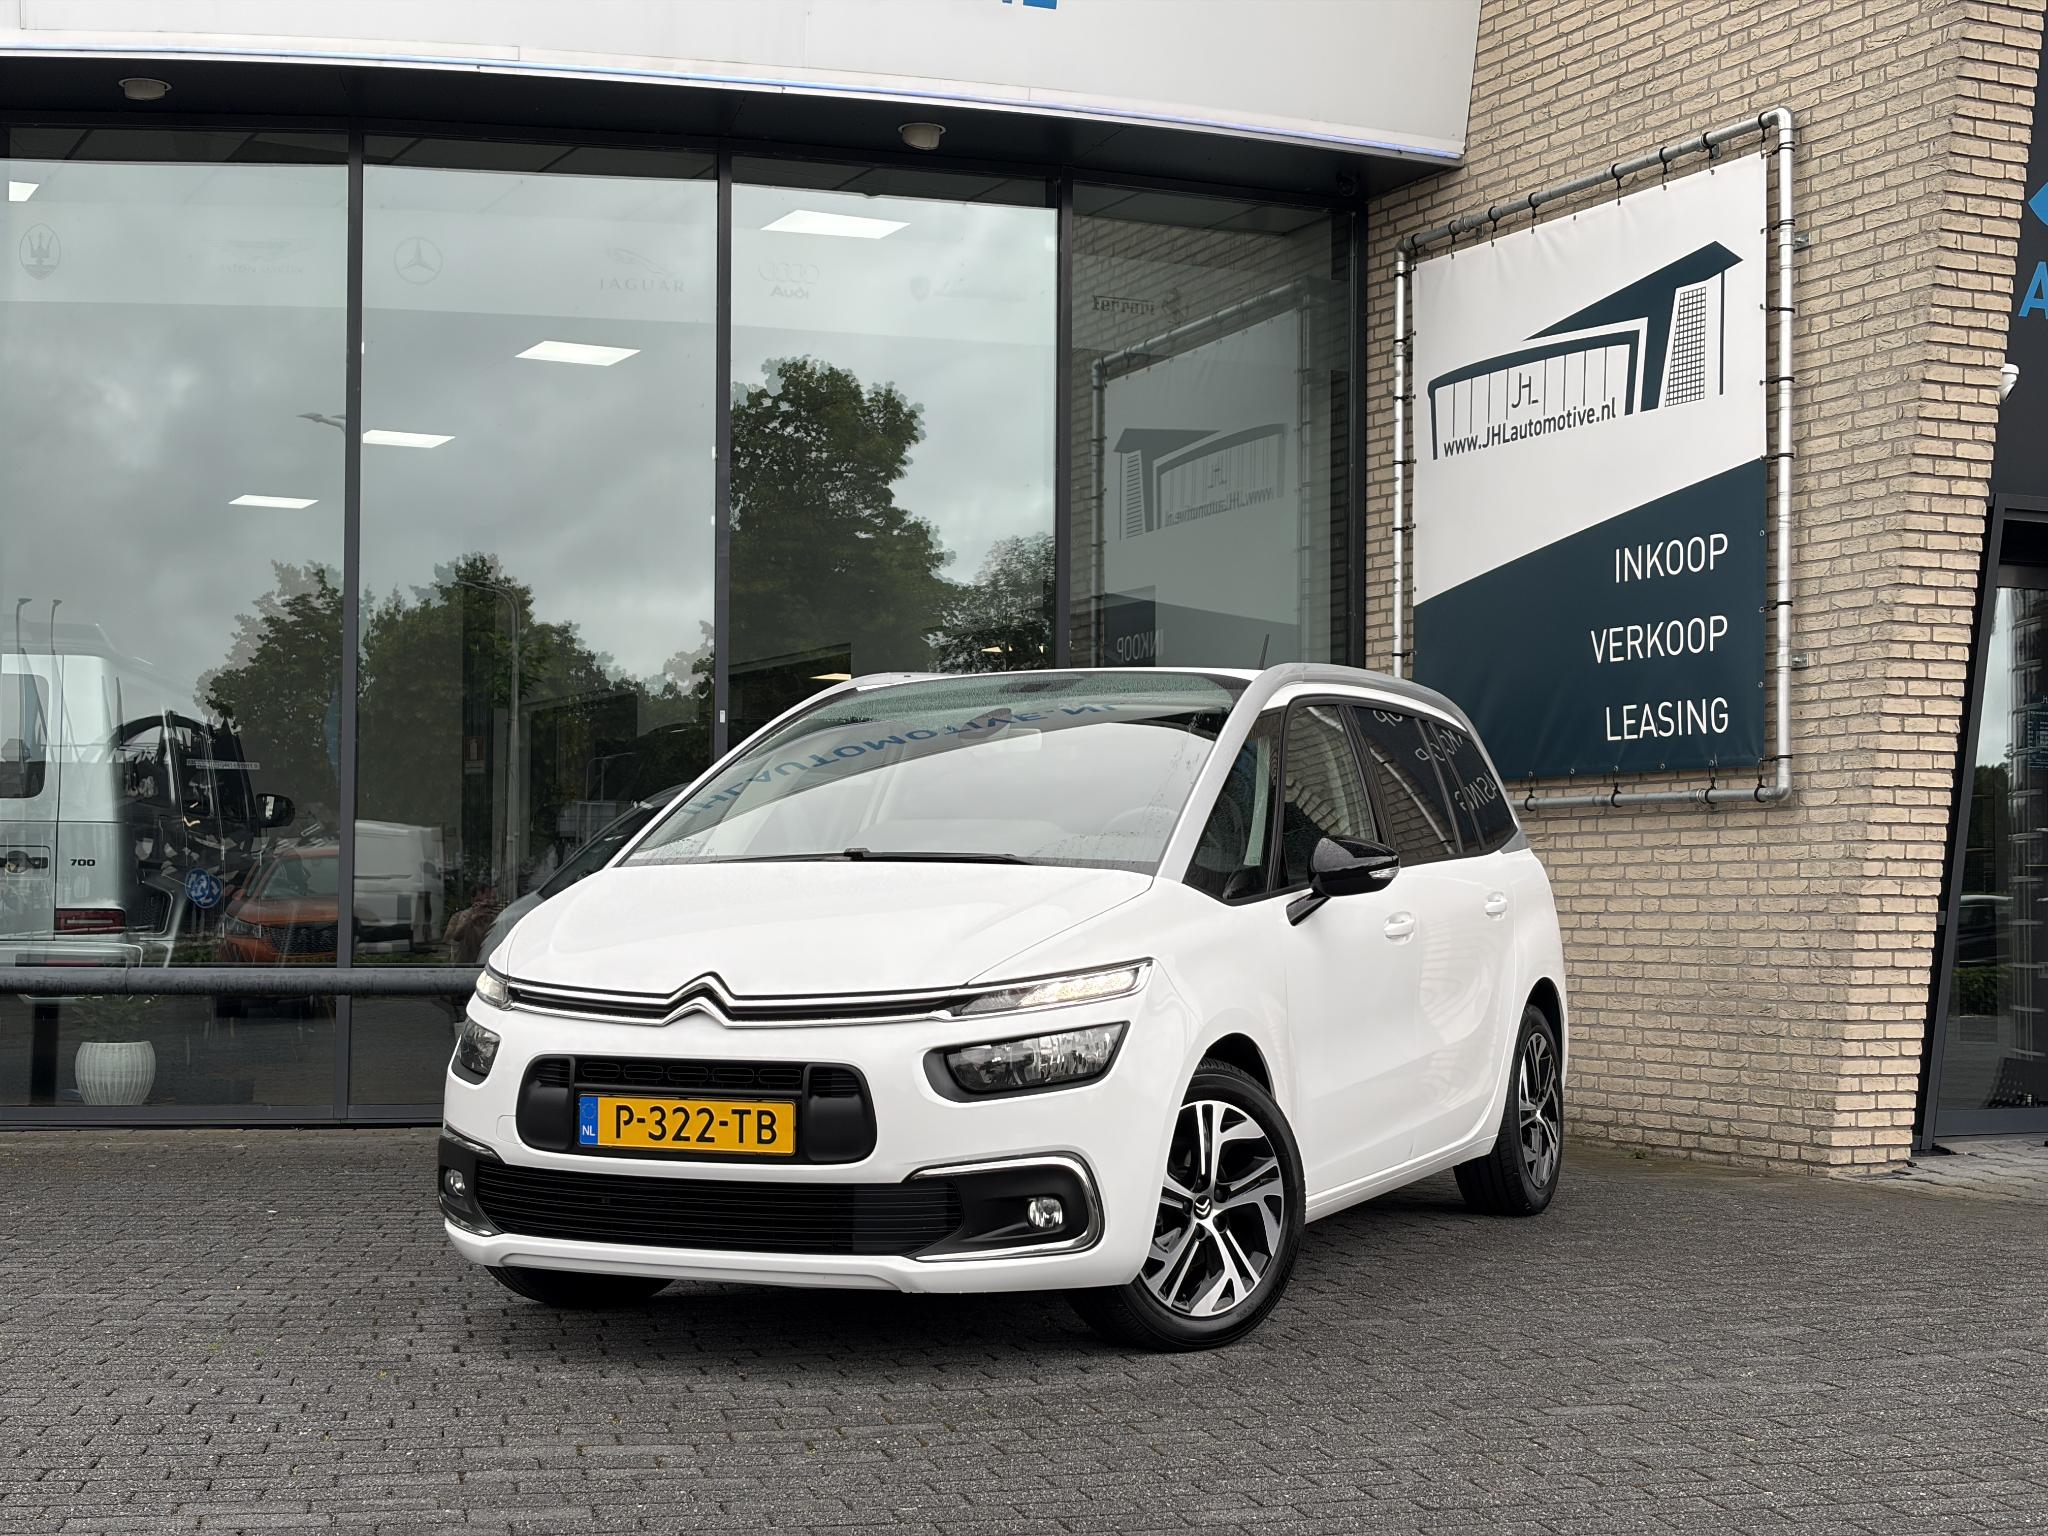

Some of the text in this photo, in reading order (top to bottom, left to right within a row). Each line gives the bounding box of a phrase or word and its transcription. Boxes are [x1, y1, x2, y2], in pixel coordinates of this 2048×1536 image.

[599, 276, 686, 293] JAGUAR
[1443, 396, 1616, 457] www.JHLautomotive.nl
[1615, 533, 1728, 583] INKOOP
[1590, 615, 1728, 663] VERKOOP
[1606, 697, 1729, 741] LEASING
[70, 858, 96, 867] 700
[582, 1104, 777, 1145] NL P-322-TB
